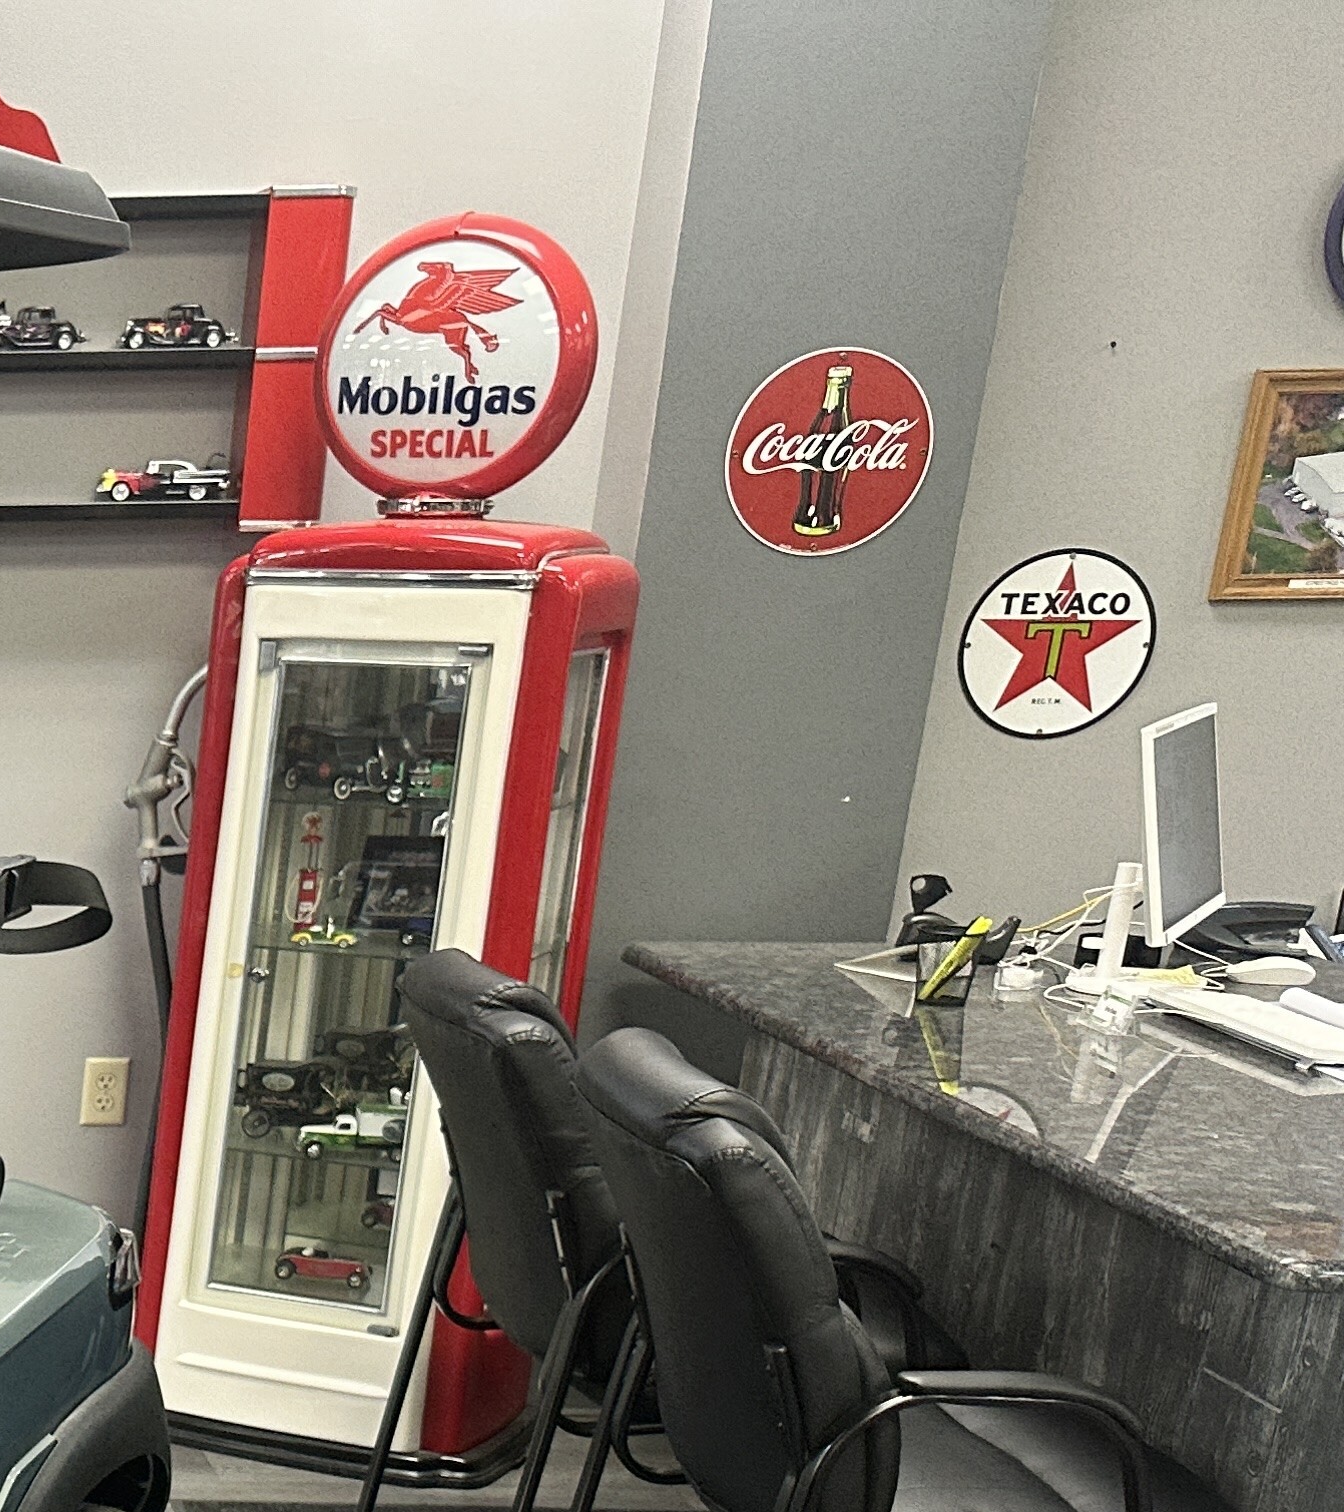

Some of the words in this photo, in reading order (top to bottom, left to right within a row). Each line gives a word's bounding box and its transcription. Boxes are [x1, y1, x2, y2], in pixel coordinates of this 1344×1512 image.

[337, 373, 537, 428] Mobilgas
[370, 429, 495, 459] SPECIAL
[742, 418, 920, 475] Coca-Cola
[1000, 591, 1132, 616] TEXACO
